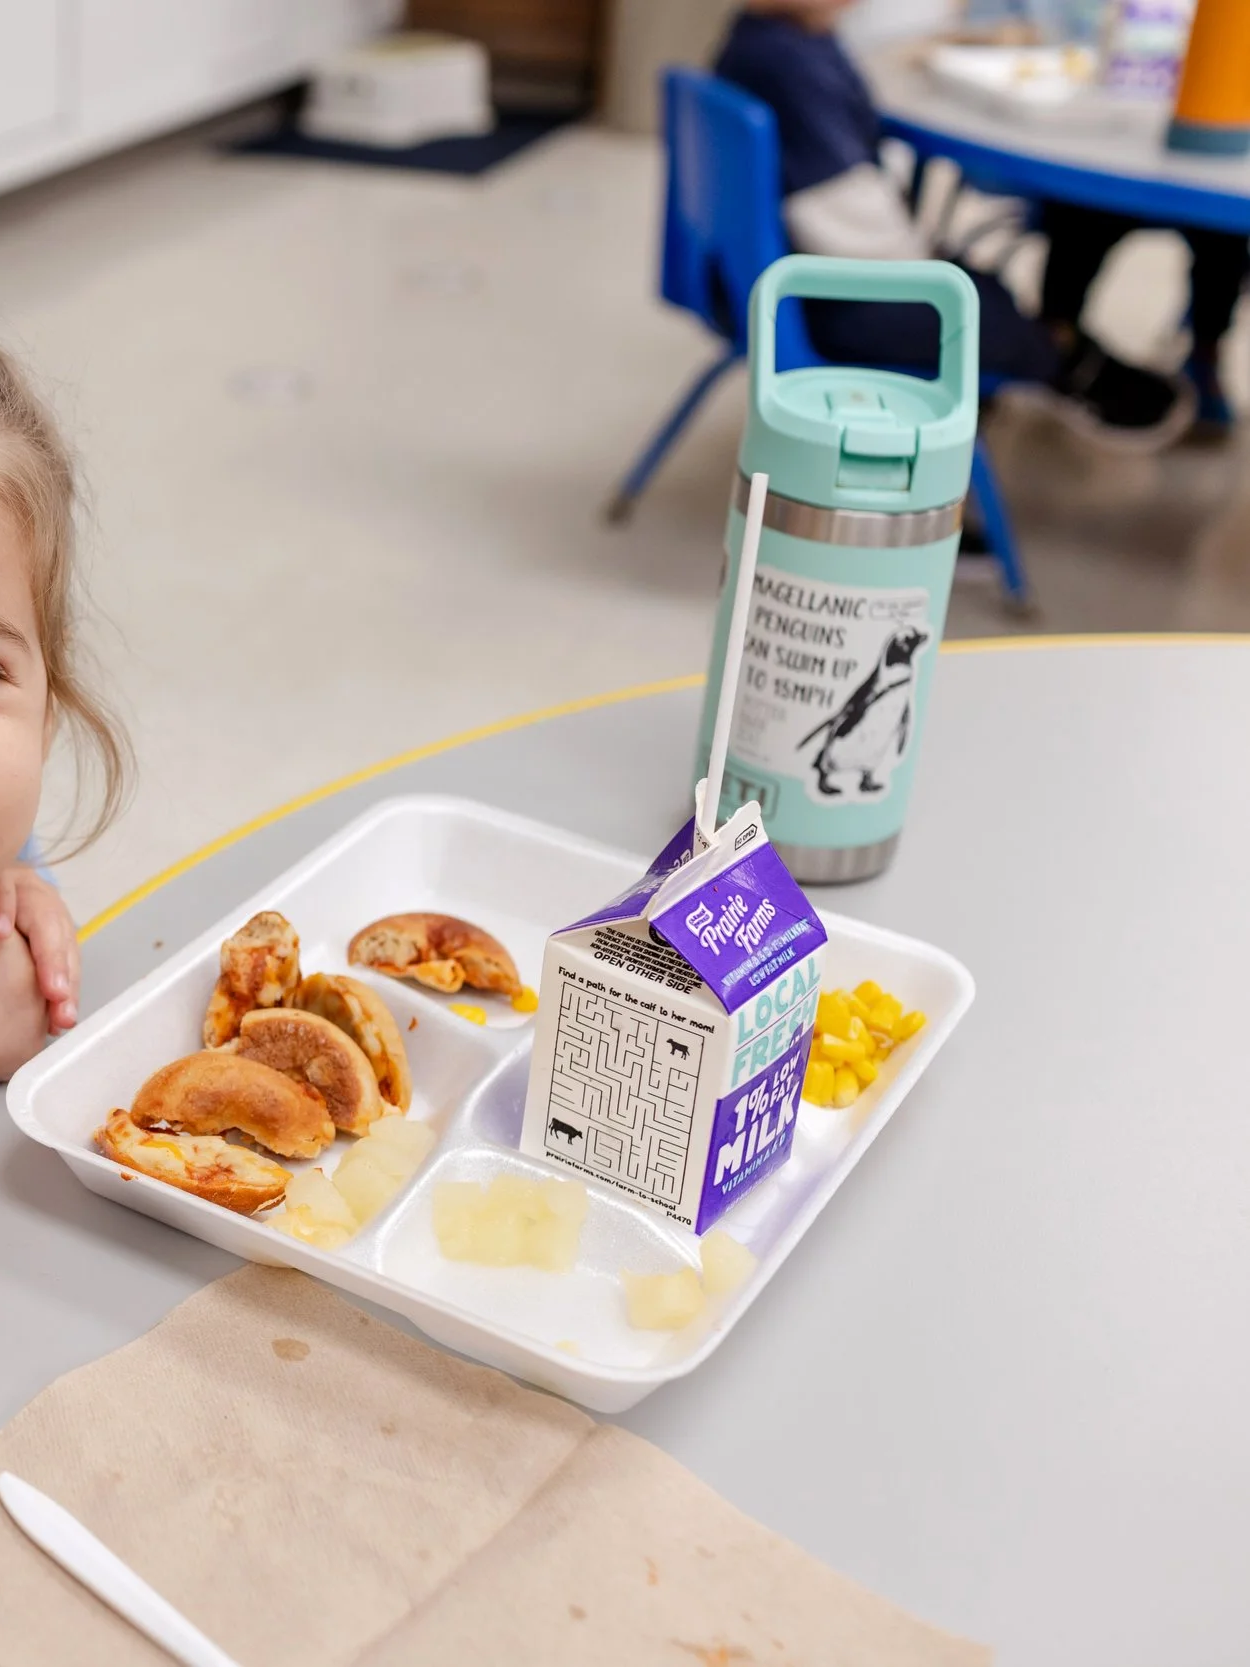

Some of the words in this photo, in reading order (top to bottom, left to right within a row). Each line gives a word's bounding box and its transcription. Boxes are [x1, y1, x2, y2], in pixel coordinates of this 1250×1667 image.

[753, 574, 867, 620] MAGELLANIC
[755, 606, 847, 649] PENGUINS
[743, 634, 771, 660] AN
[776, 645, 825, 676] SWIM
[832, 658, 859, 680] UP
[746, 666, 766, 690] TO
[742, 828, 755, 842] OPEN
[700, 894, 748, 956] Prairie
[734, 898, 776, 956] Farms
[594, 951, 625, 968] OPEN
[626, 963, 664, 984] OTHER
[665, 980, 694, 995] SIDE
[776, 945, 797, 966] MILK
[558, 966, 576, 981] Find
[578, 976, 584, 984] a
[586, 979, 606, 993] path
[609, 987, 622, 998] for
[624, 993, 638, 1005] the
[640, 1000, 657, 1012] calf
[659, 1006, 668, 1017] to
[671, 1011, 686, 1023] her
[689, 1019, 715, 1034] mom!
[738, 956, 821, 1046] LOCAL
[734, 1079, 768, 1134] 1%
[773, 1050, 801, 1089] LOW
[770, 1073, 794, 1108] FAT
[713, 1081, 800, 1186] MILK
[546, 1150, 677, 1212] prairiefarms.com/farm-to-school
[722, 1155, 763, 1195] VITAMIN
